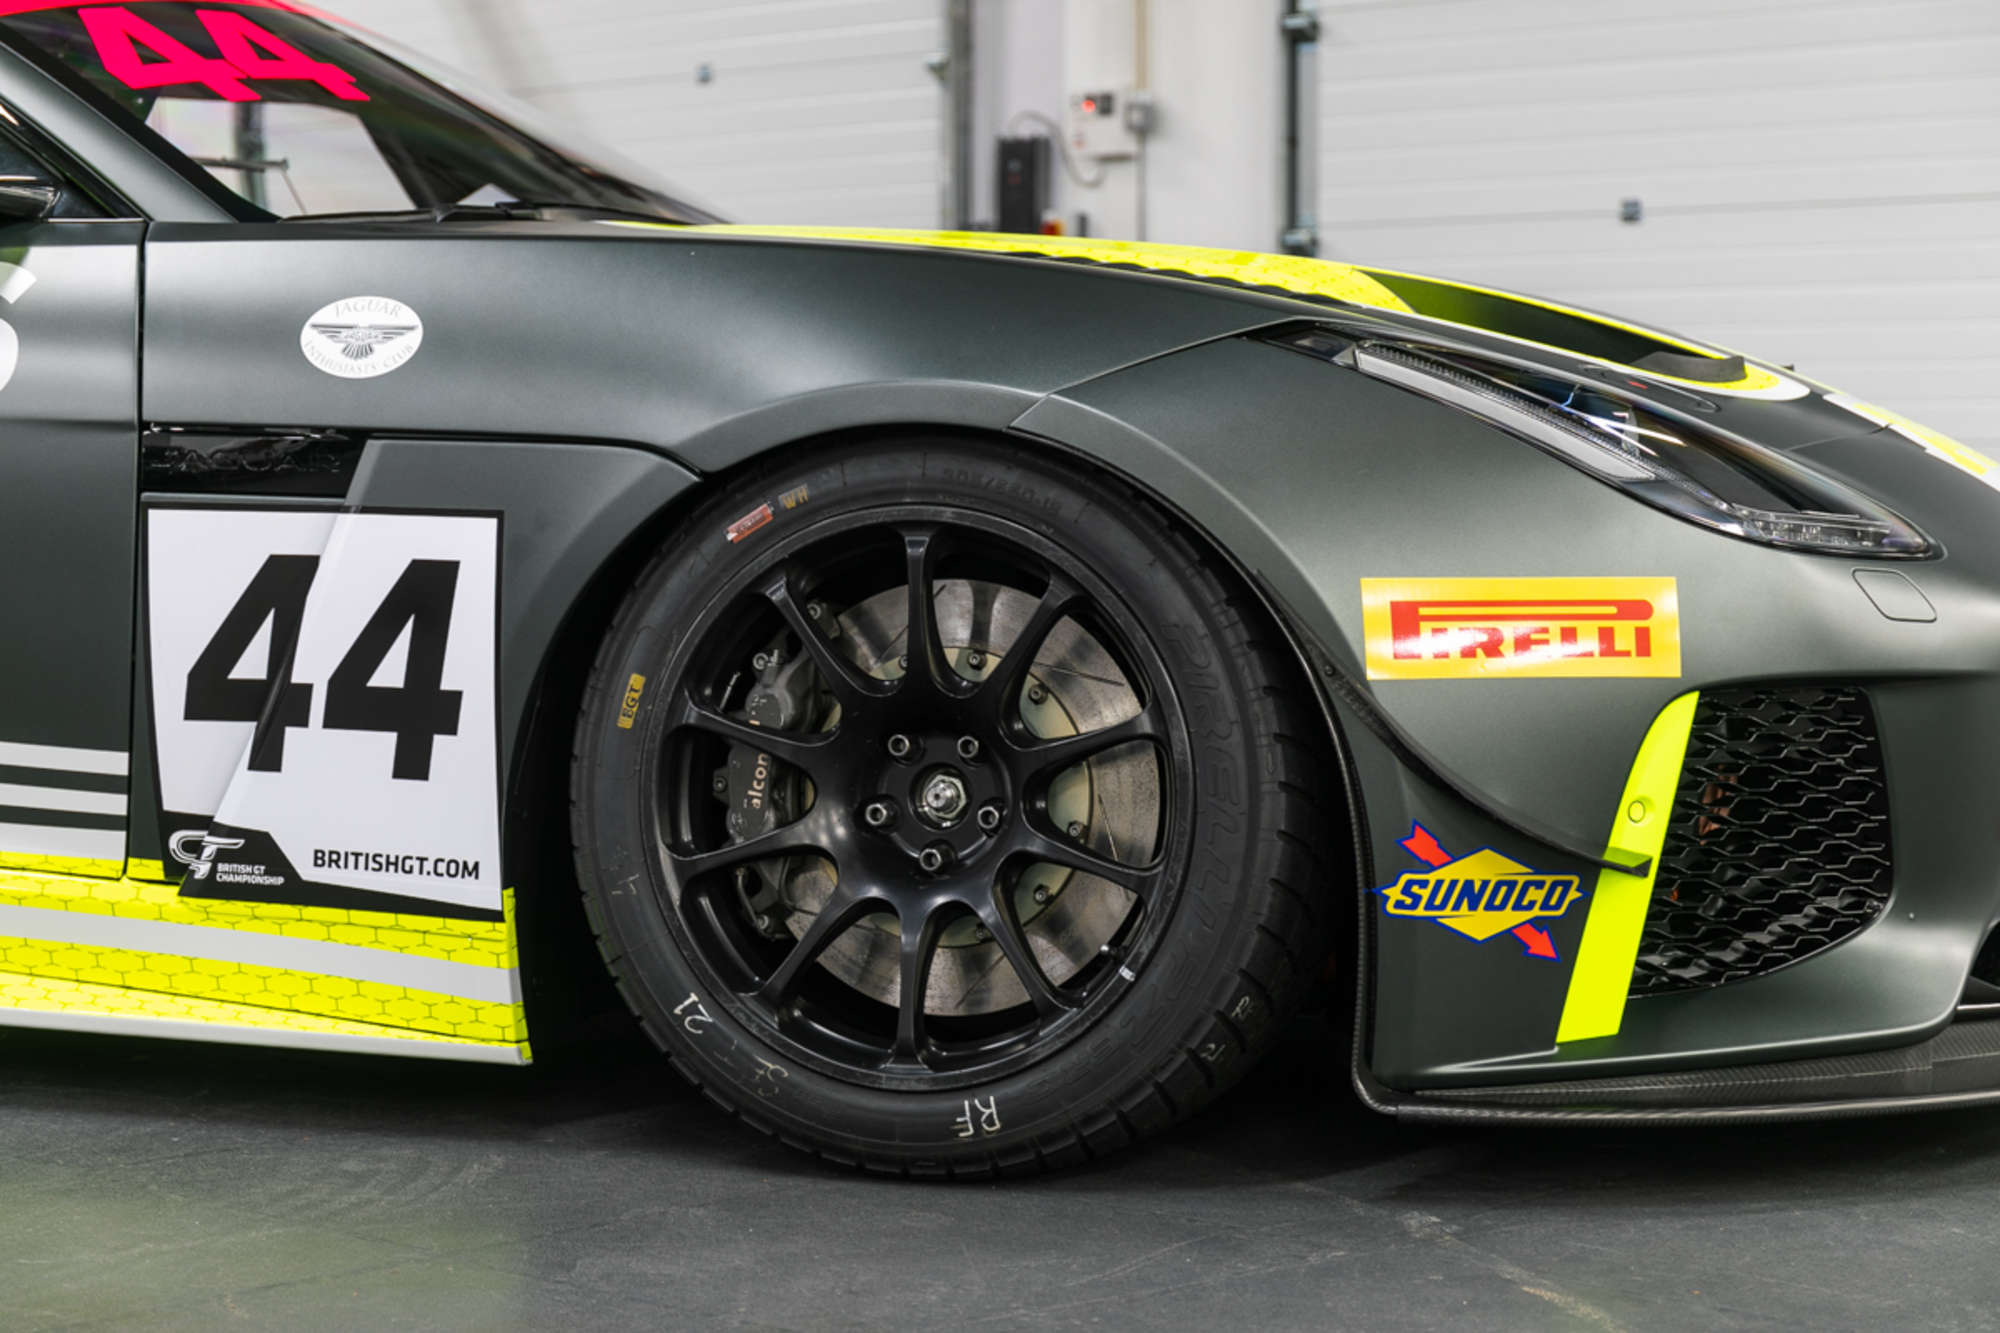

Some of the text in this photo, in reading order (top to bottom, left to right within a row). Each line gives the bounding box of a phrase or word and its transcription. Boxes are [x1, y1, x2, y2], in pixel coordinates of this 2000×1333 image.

[77, 6, 371, 103] 44
[335, 299, 401, 318] JAGUAR
[1389, 599, 1654, 660] PIRELLI
[184, 553, 464, 782] 44
[216, 872, 285, 886] CHAMPIONSHIP
[217, 862, 252, 873] BRITISH
[312, 849, 480, 881] BRITISHGT.COM
[1393, 878, 1575, 912] SUNOCO
[951, 1095, 1001, 1138] RF
